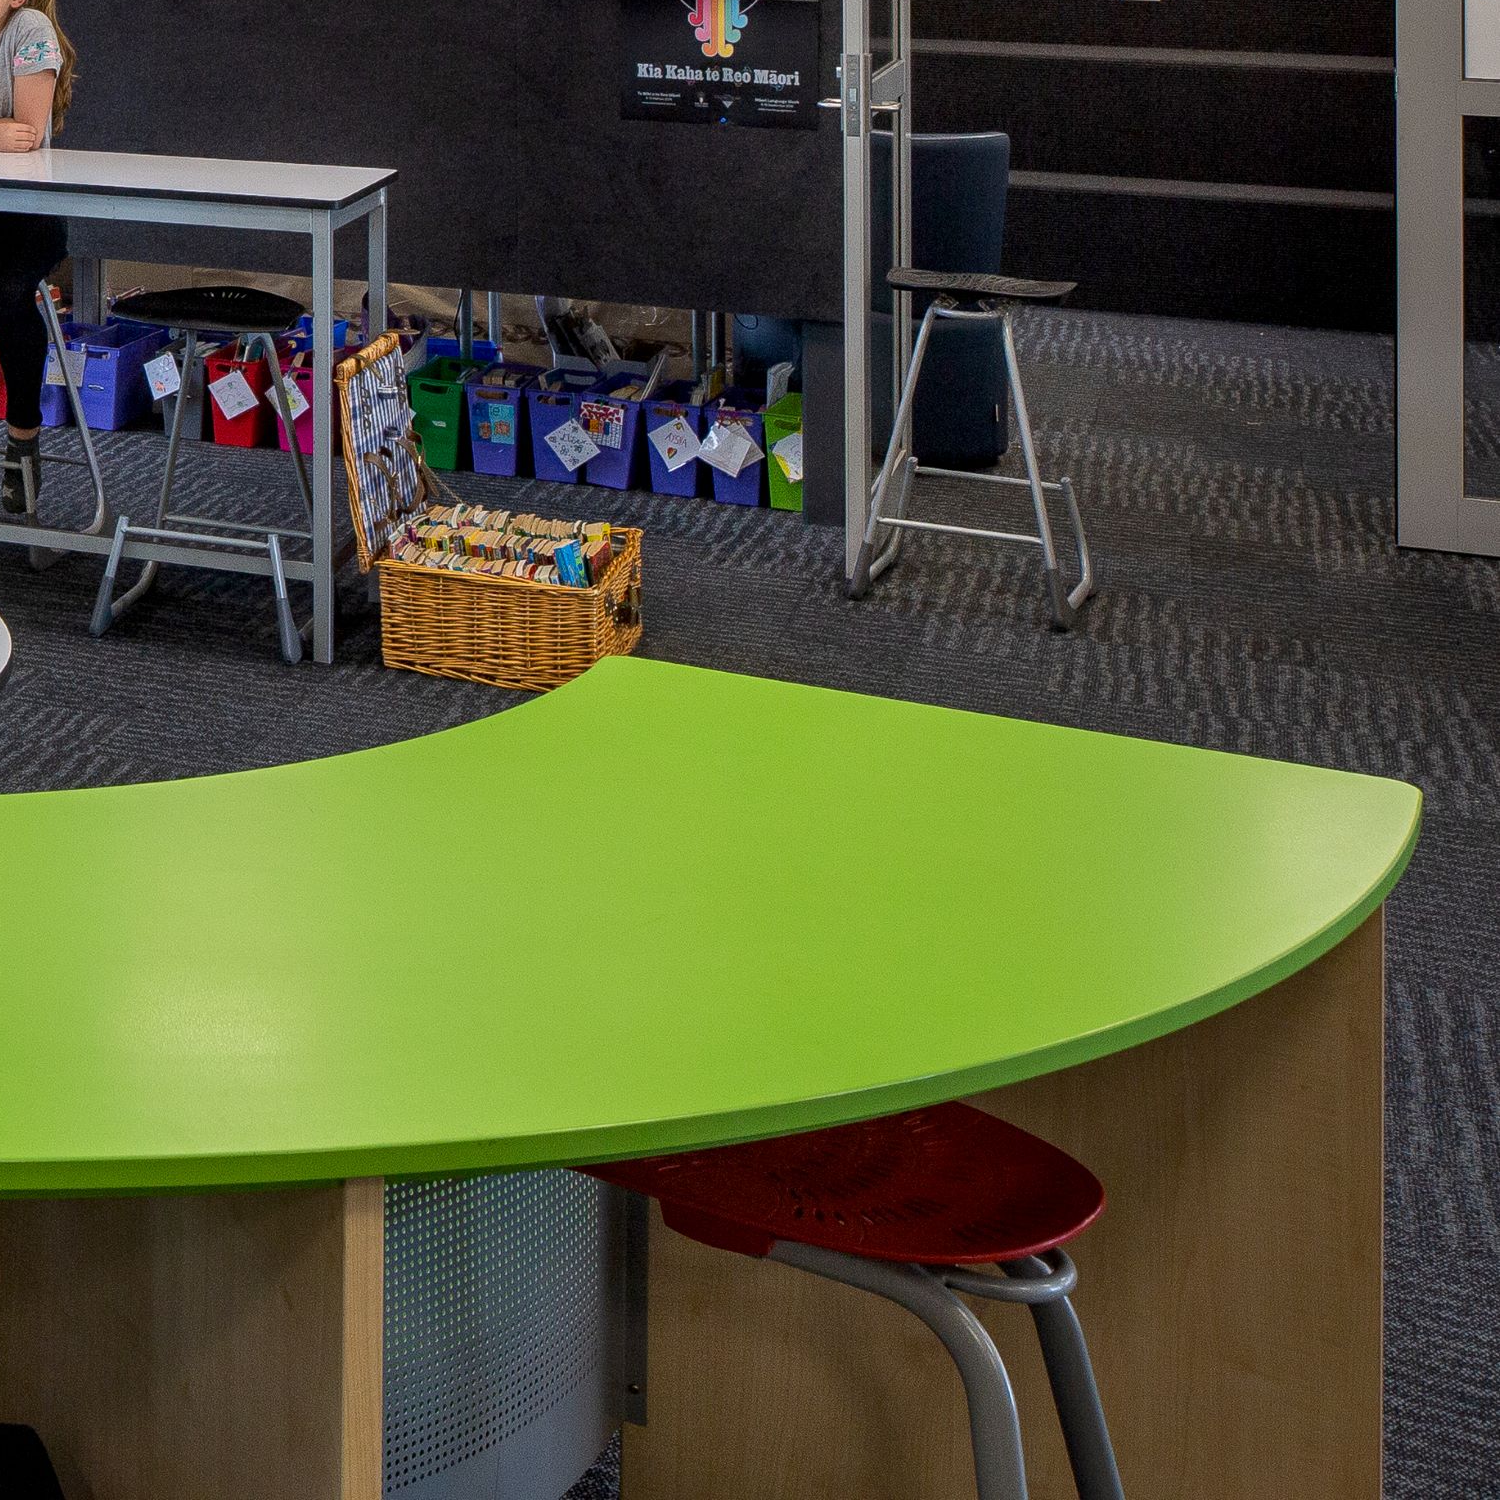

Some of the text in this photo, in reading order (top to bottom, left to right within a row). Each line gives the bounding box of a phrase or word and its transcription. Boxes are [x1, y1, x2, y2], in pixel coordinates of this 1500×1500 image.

[637, 63, 663, 79] Kia
[665, 64, 704, 81] Kaha
[722, 67, 752, 83] Reo
